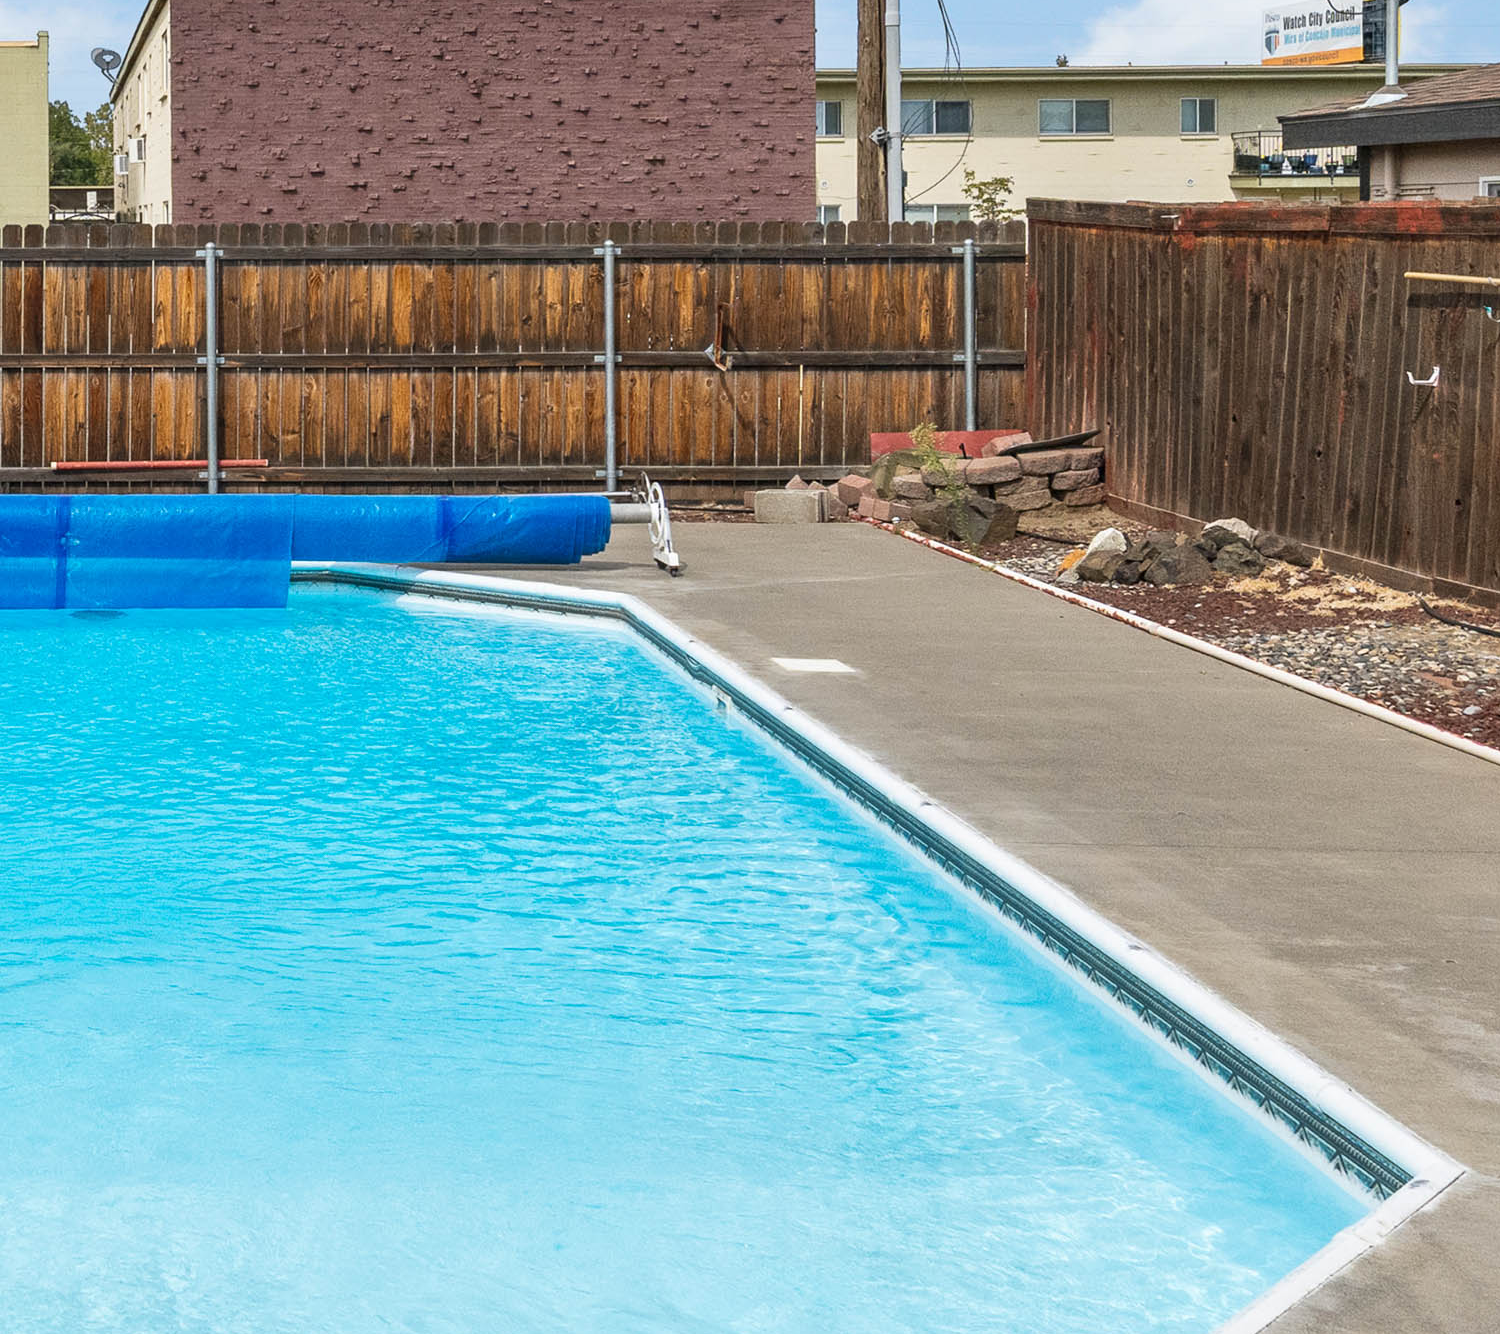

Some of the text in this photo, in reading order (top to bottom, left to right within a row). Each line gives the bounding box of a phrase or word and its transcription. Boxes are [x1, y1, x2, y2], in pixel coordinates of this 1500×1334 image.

[1283, 6, 1355, 31] Watch City Council
